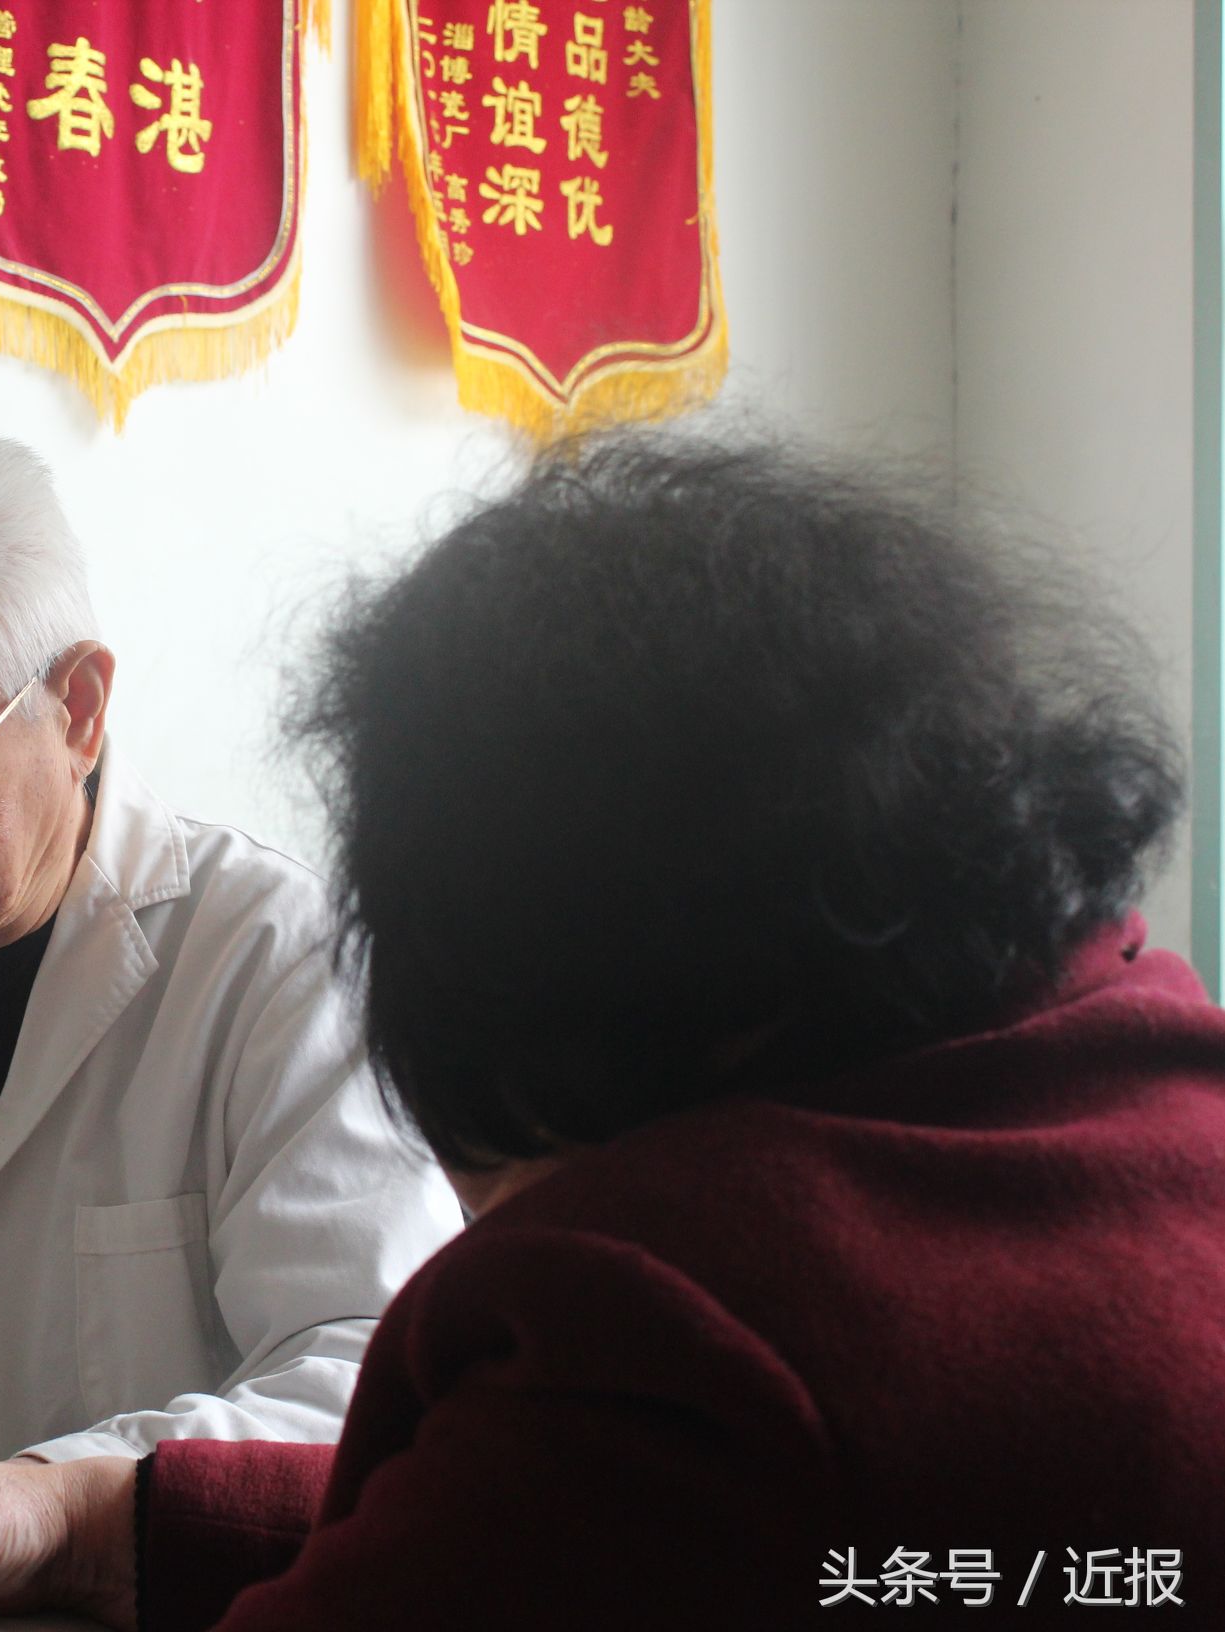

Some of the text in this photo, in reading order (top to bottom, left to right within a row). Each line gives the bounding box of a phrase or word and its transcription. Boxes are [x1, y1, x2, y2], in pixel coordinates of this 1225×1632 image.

[27, 36, 115, 157] 春
[129, 57, 213, 174] 湛
[478, 0, 549, 236] 情谊深
[560, 11, 614, 246] 品德优
